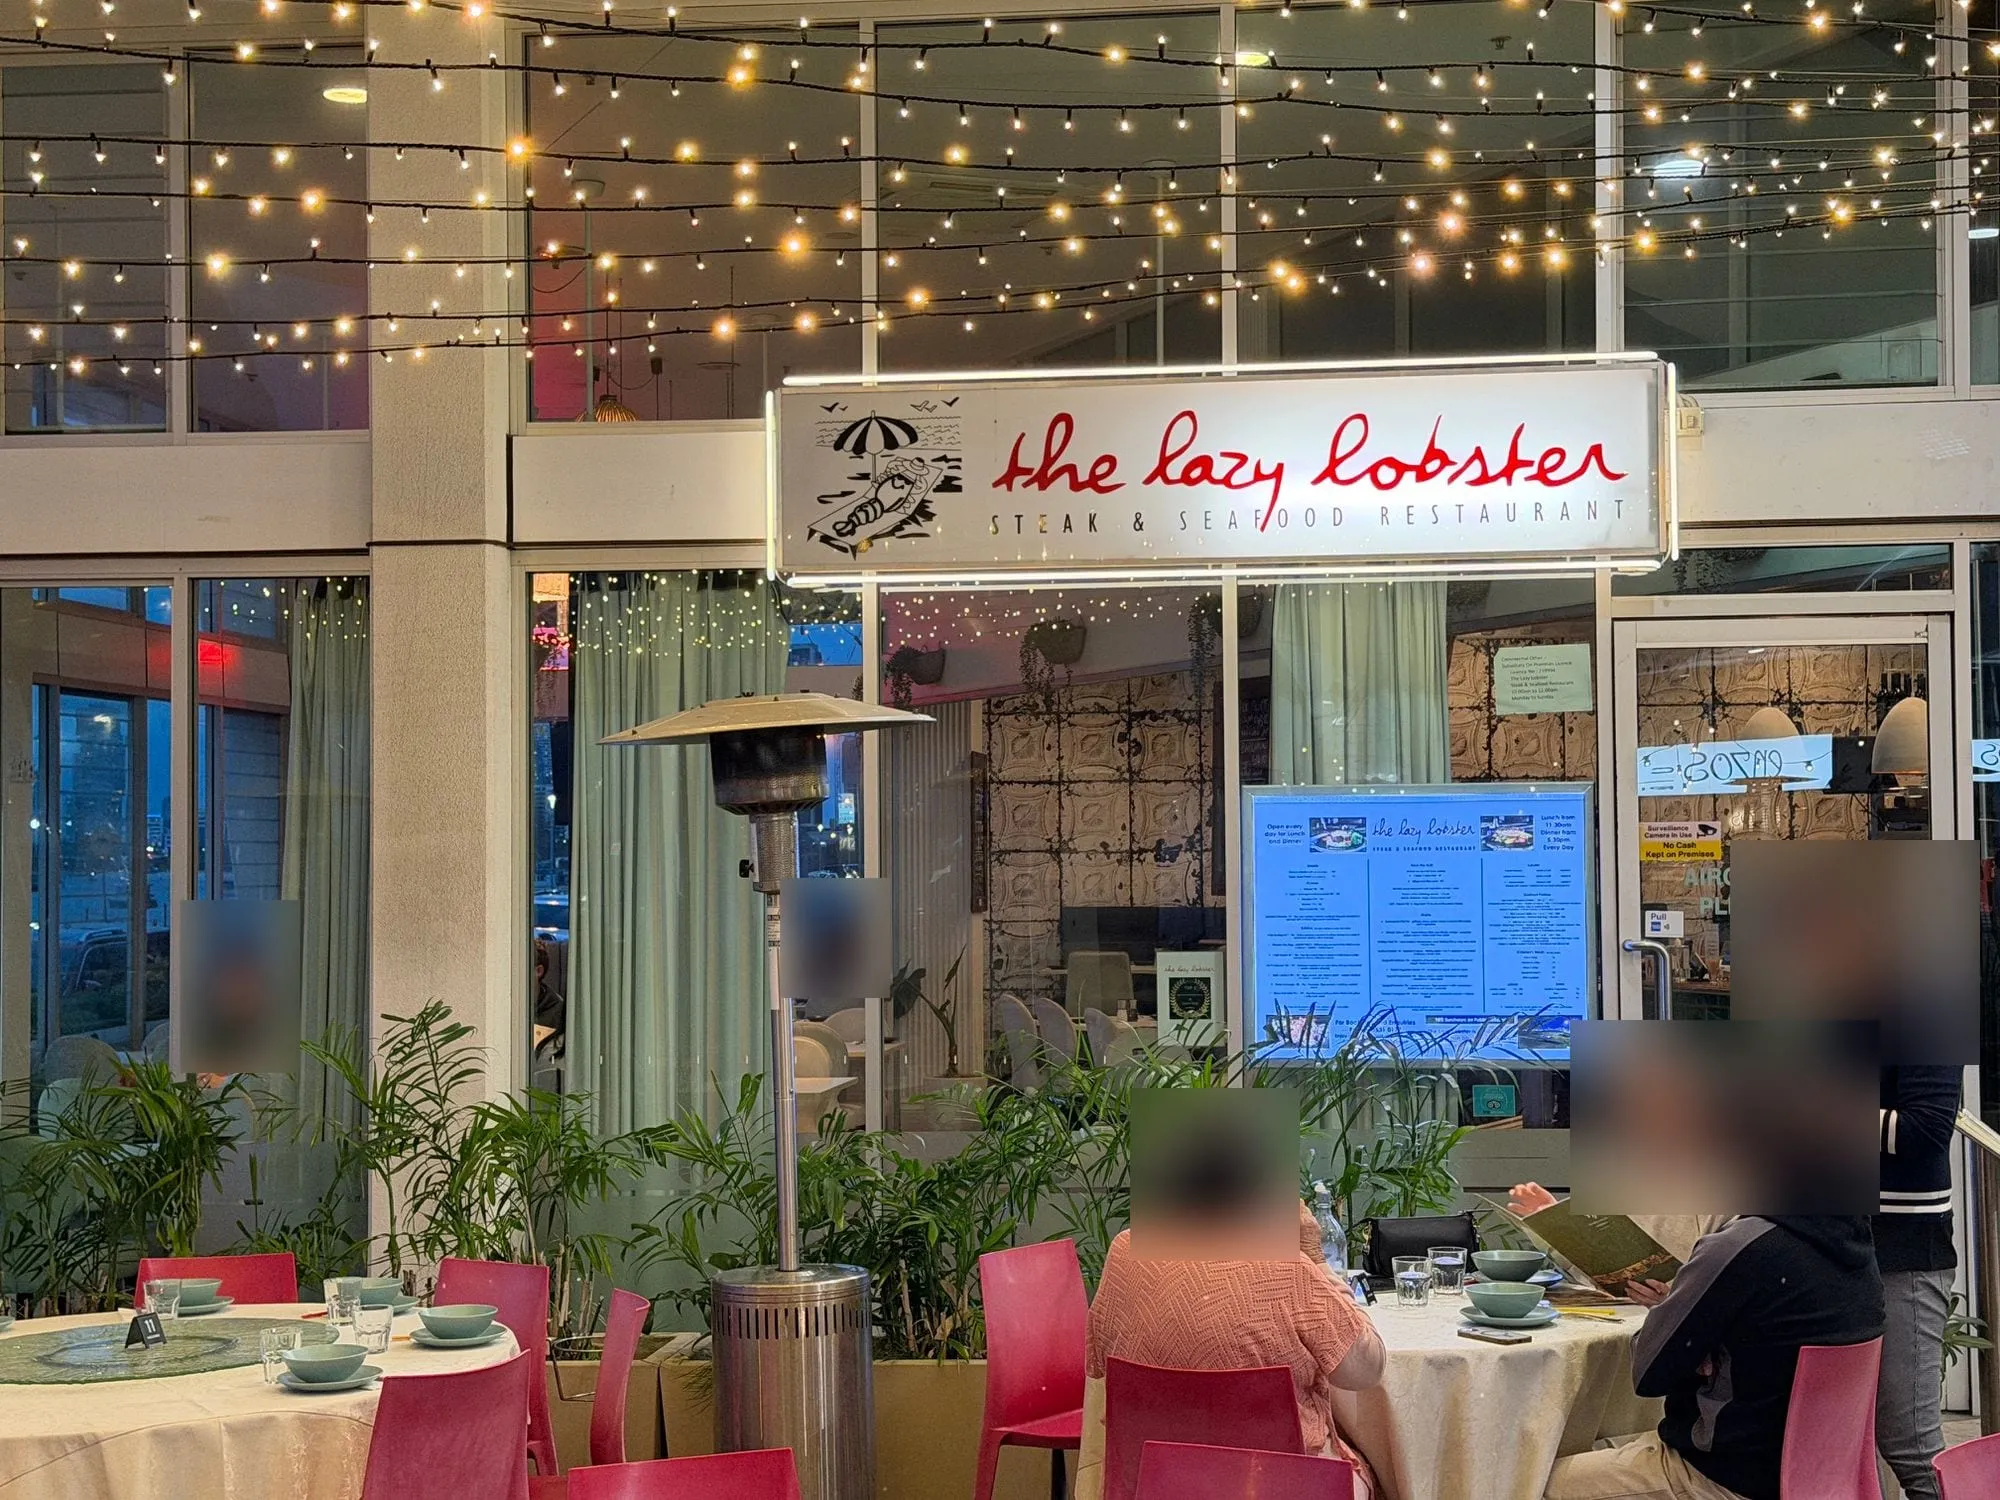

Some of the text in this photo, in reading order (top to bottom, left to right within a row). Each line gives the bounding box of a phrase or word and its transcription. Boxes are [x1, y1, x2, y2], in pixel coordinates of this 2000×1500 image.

[991, 410, 1630, 533] the lazy lobster
[988, 500, 1625, 535] STEAK & SEAFOOD RESTAURANT
[1372, 817, 1476, 845] the lazy lobster
[1676, 841, 1697, 849] Cash
[1645, 851, 1665, 860] Kept
[1678, 850, 1715, 858] Premises
[1650, 912, 1667, 921] Pull
[143, 1318, 157, 1334] 11
